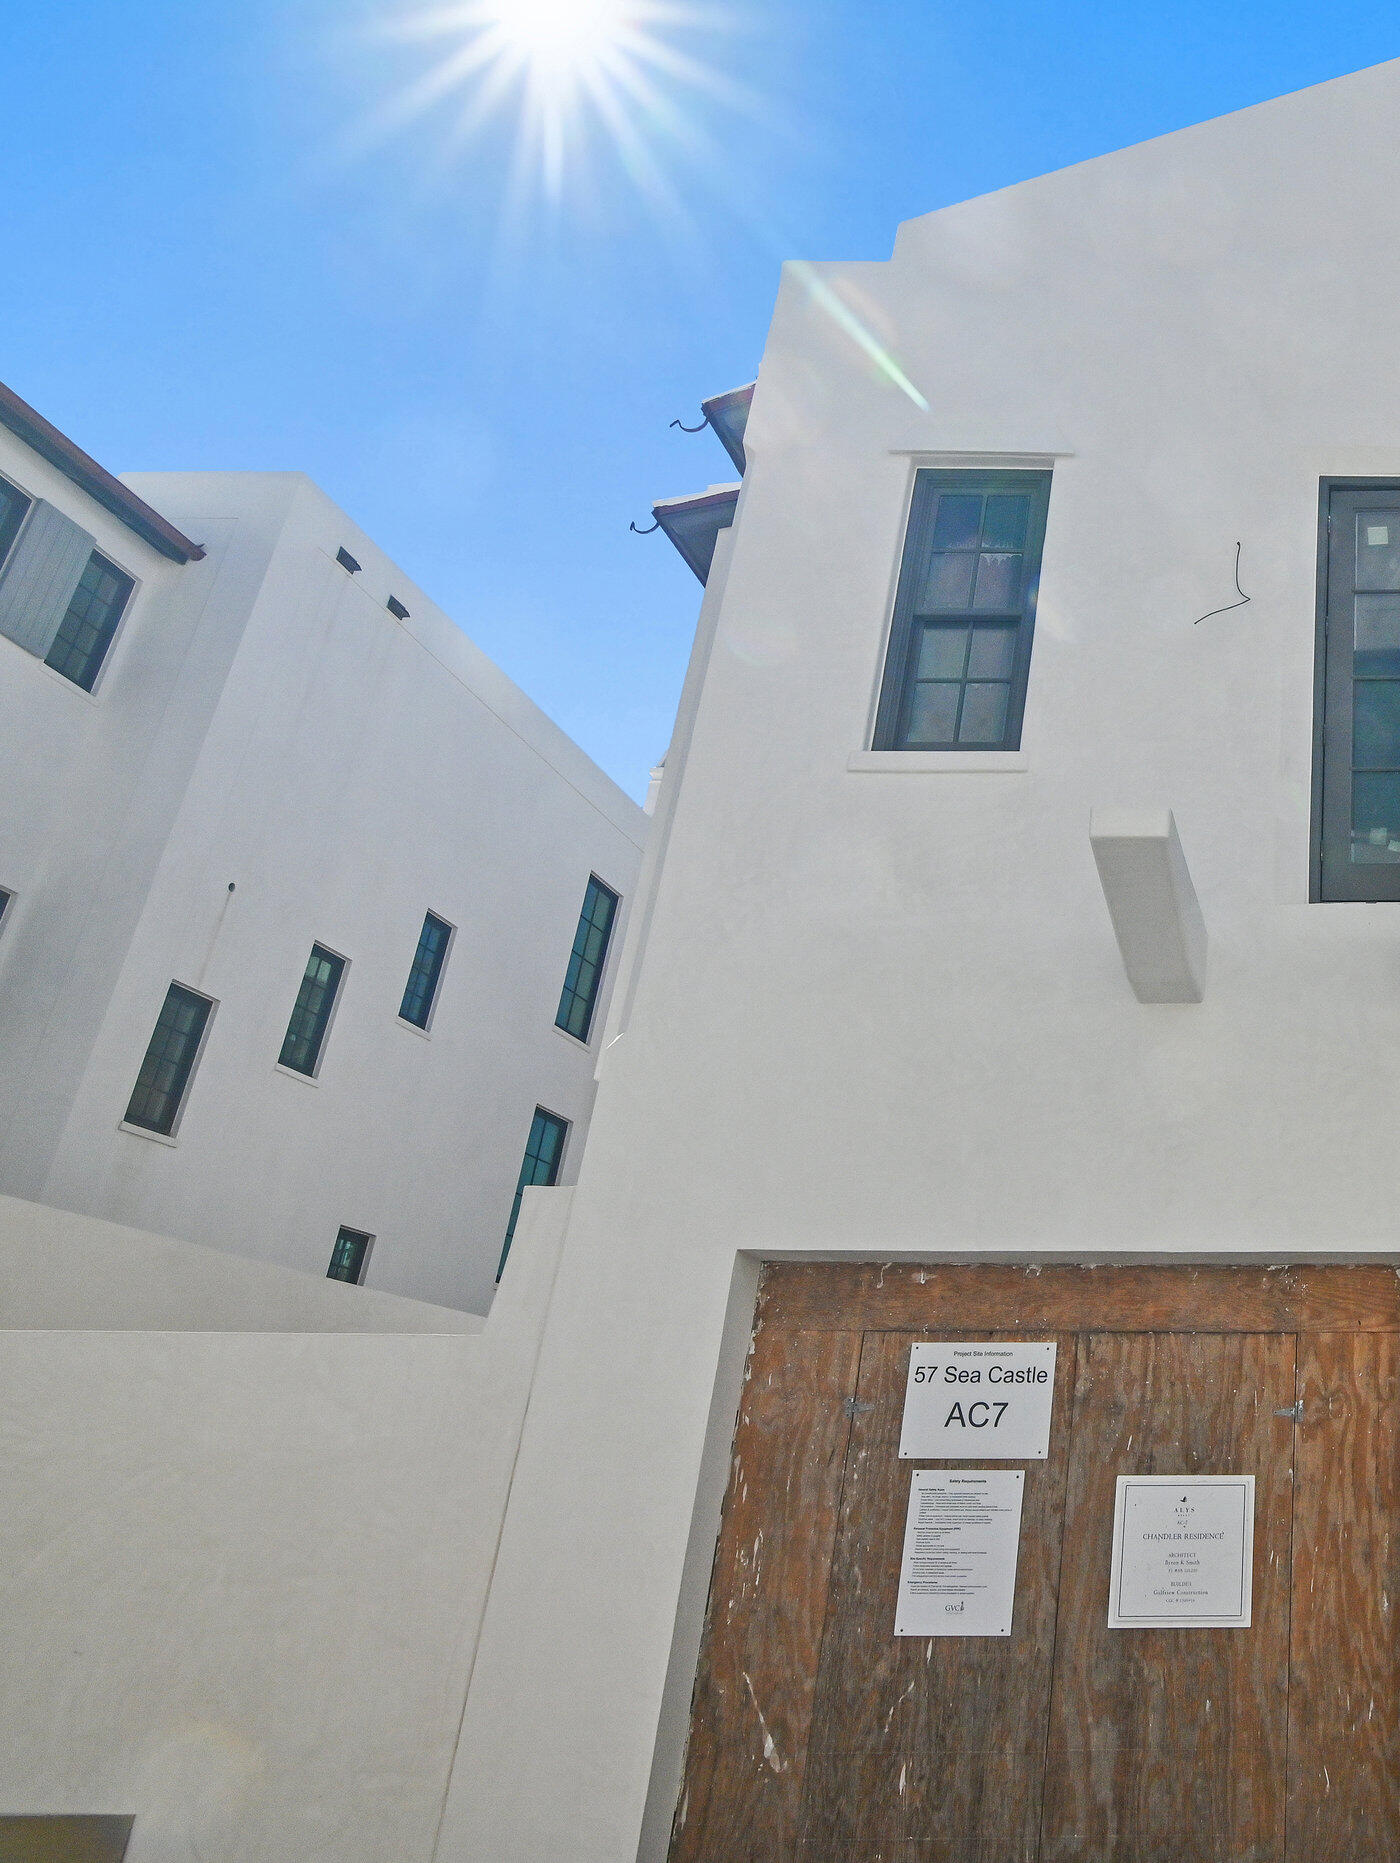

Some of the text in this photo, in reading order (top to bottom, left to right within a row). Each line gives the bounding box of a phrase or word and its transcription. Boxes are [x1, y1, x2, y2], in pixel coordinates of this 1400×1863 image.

[914, 1366, 1048, 1383] 57 Sea Castle
[944, 1402, 1009, 1428] AC7
